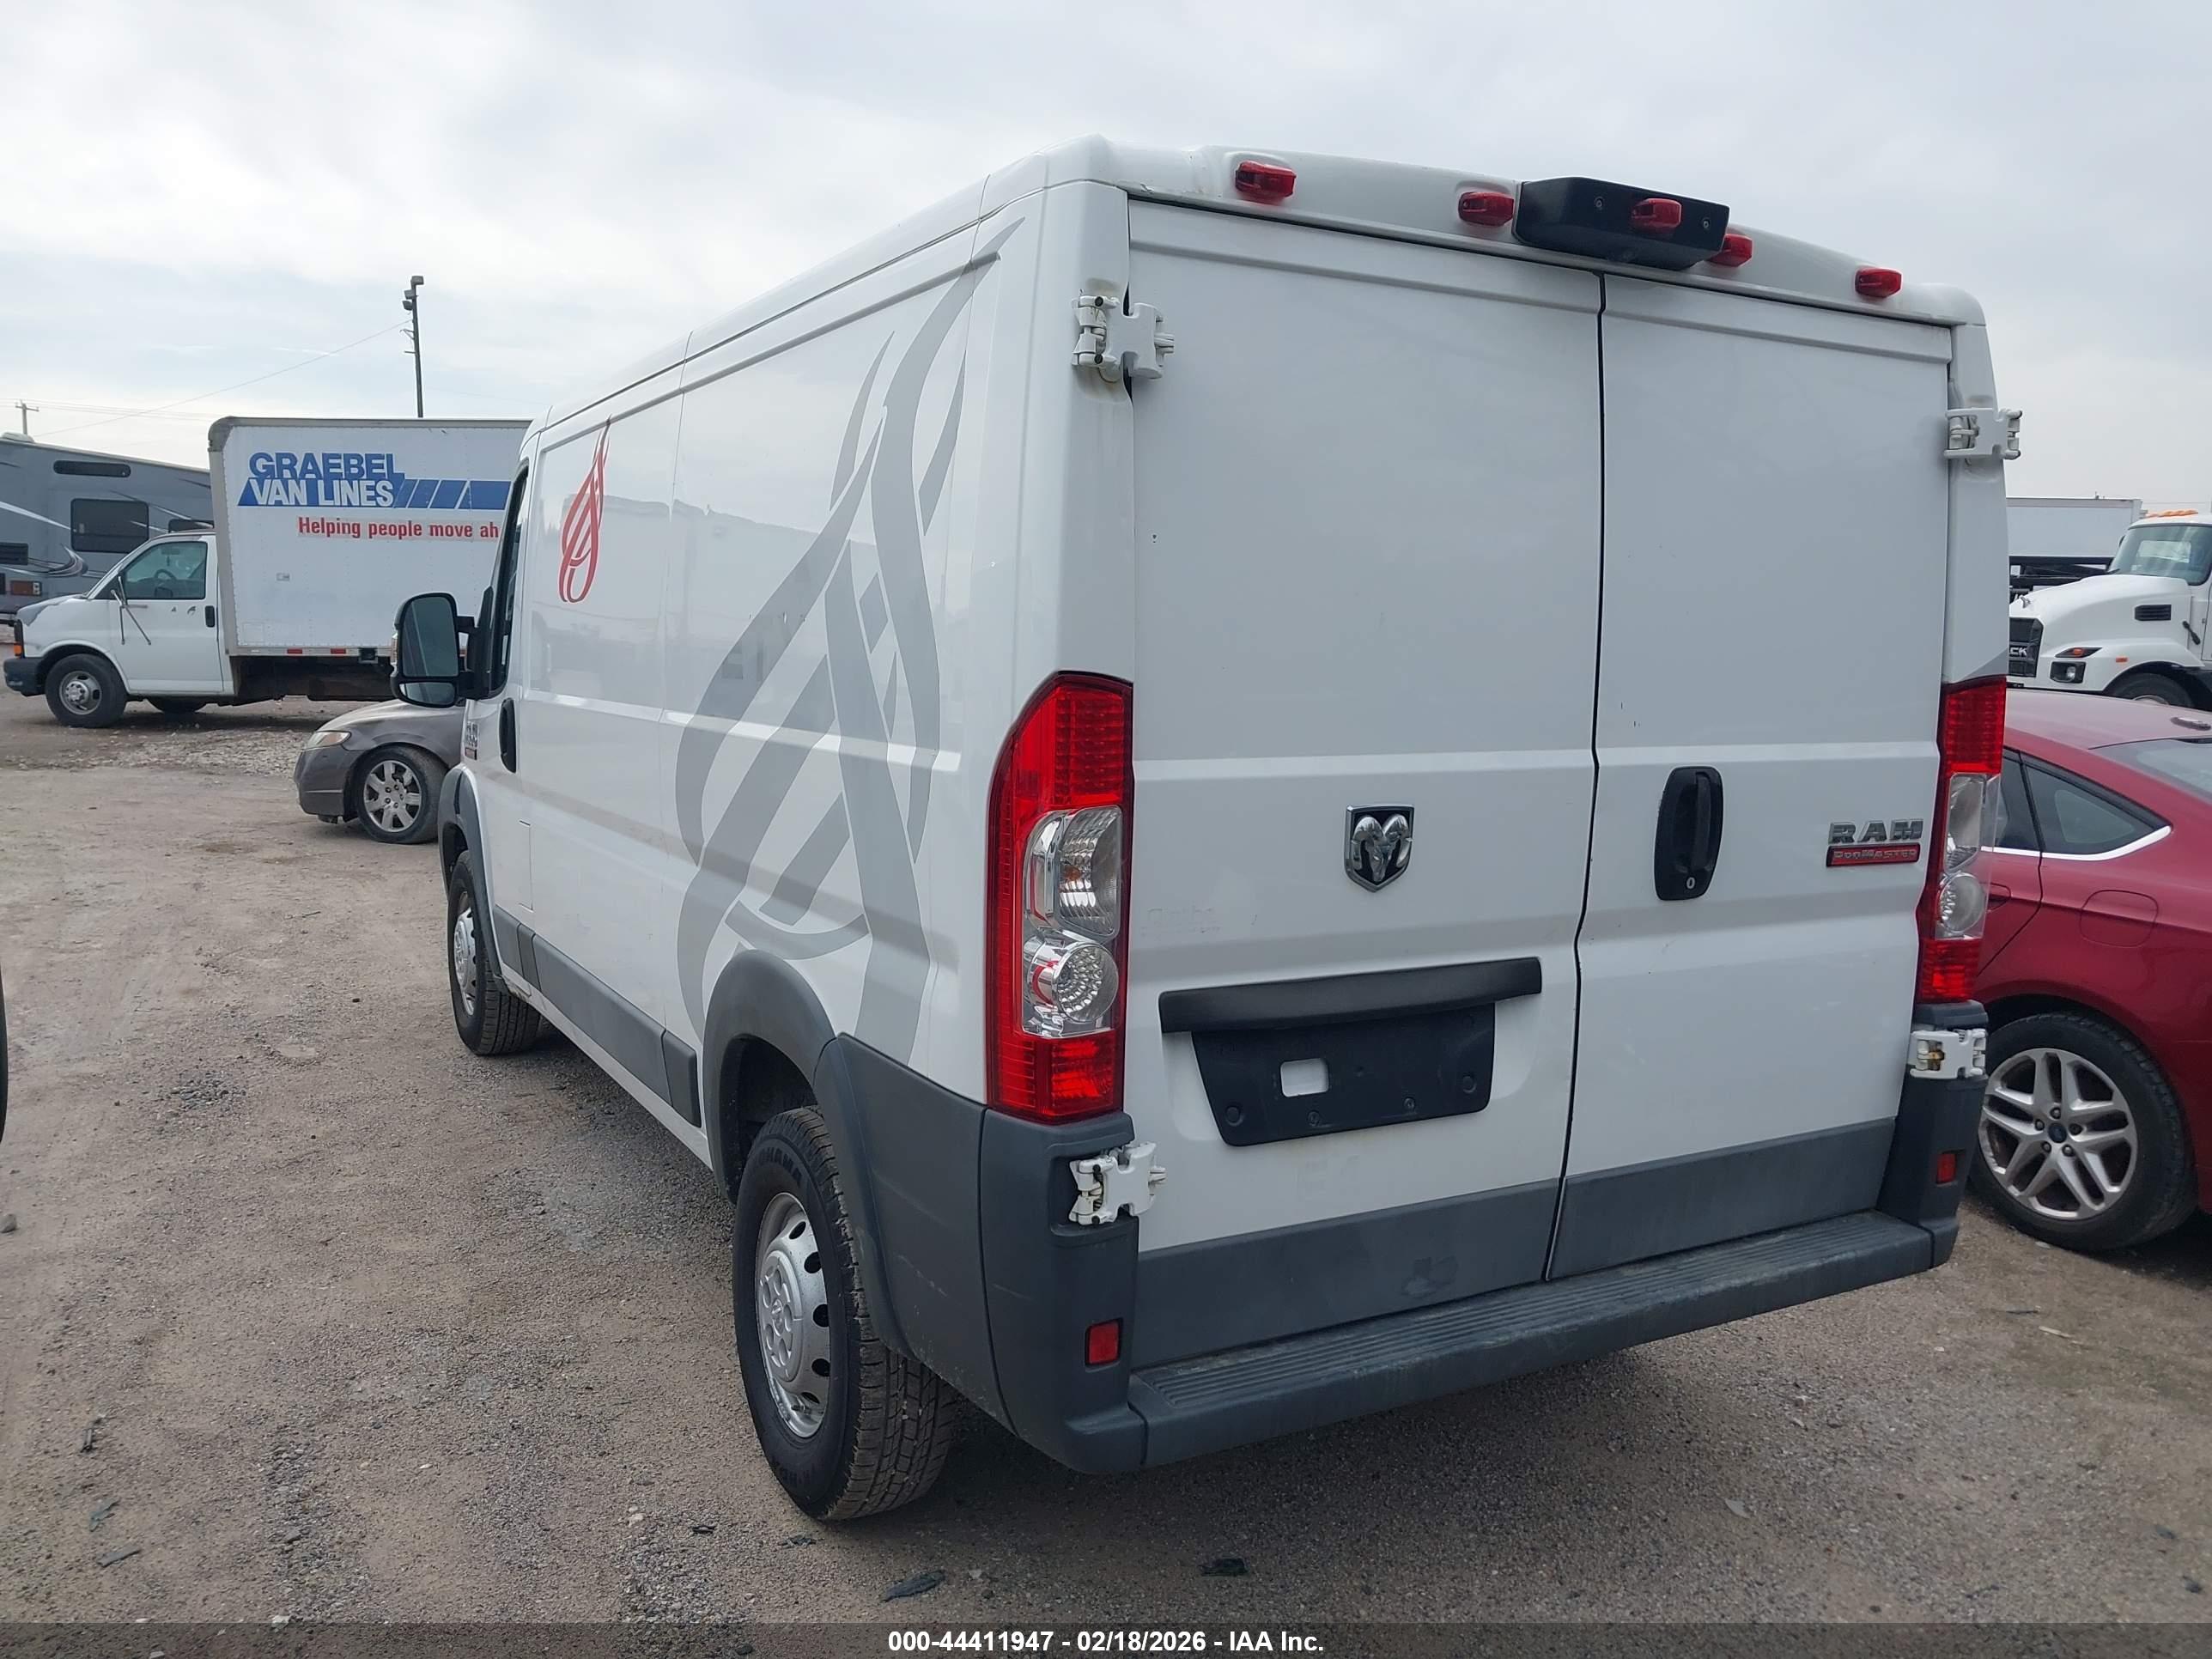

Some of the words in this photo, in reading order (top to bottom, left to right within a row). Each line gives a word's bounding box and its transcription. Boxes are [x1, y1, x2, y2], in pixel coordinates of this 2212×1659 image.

[249, 452, 405, 480] GRAEBEL
[249, 477, 307, 506] VAN
[318, 479, 394, 507] LINES
[298, 517, 361, 538] Helping
[368, 520, 422, 540] people
[429, 523, 472, 538] move
[1828, 819, 1924, 844] RAM
